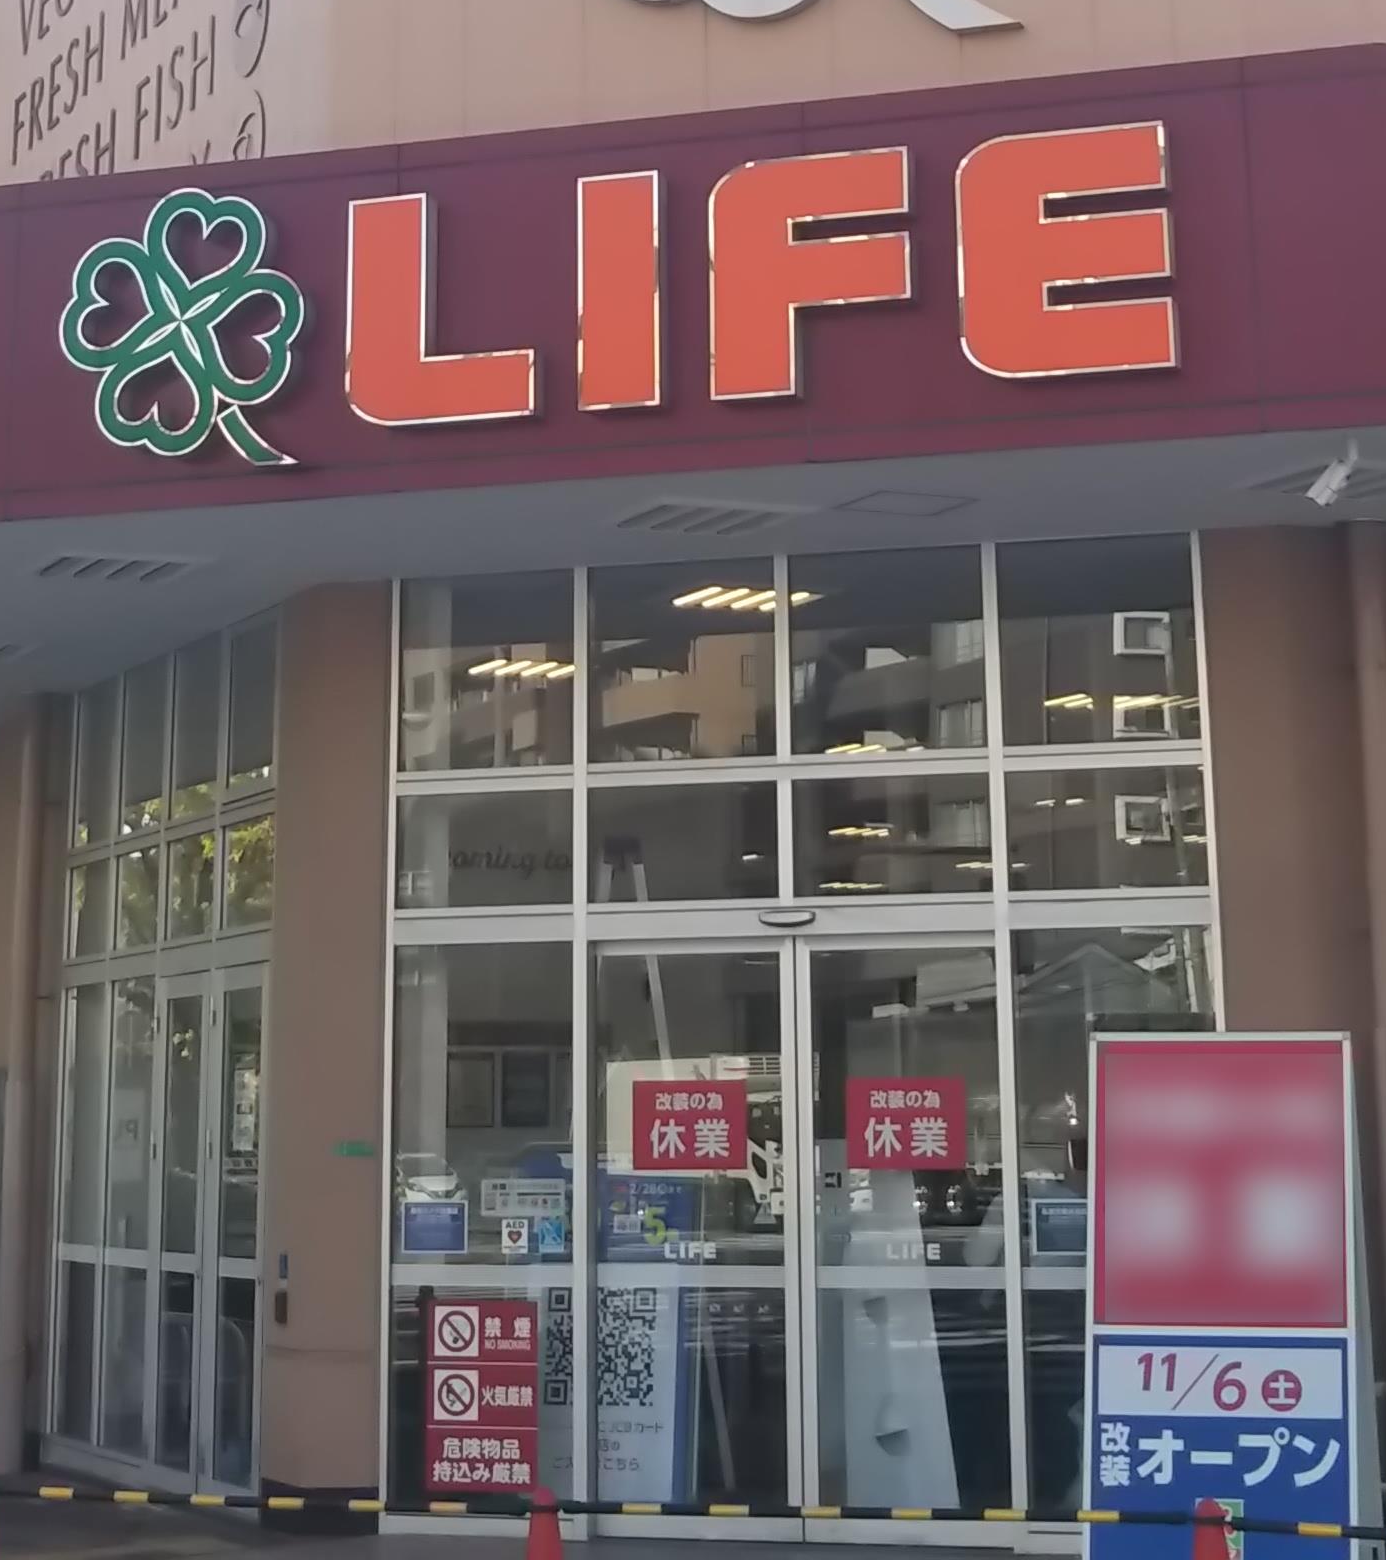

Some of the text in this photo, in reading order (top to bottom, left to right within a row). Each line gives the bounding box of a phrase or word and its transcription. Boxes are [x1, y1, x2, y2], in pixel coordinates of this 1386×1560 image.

[11, 10, 106, 166] FRESH
[132, 14, 215, 160] FISH
[345, 120, 1179, 426] LIFE
[449, 845, 535, 880] oming
[649, 1118, 730, 1159] 休業
[864, 1116, 948, 1158] 休業
[505, 1221, 525, 1229] AED
[664, 1242, 717, 1259] LIFE
[886, 1243, 941, 1261] LIFE
[1137, 1352, 1247, 1411] 11/6
[442, 1437, 521, 1460] 危険物品
[1099, 1421, 1341, 1487] 改装 オープン
[432, 1461, 531, 1484] 持込み厳禁
